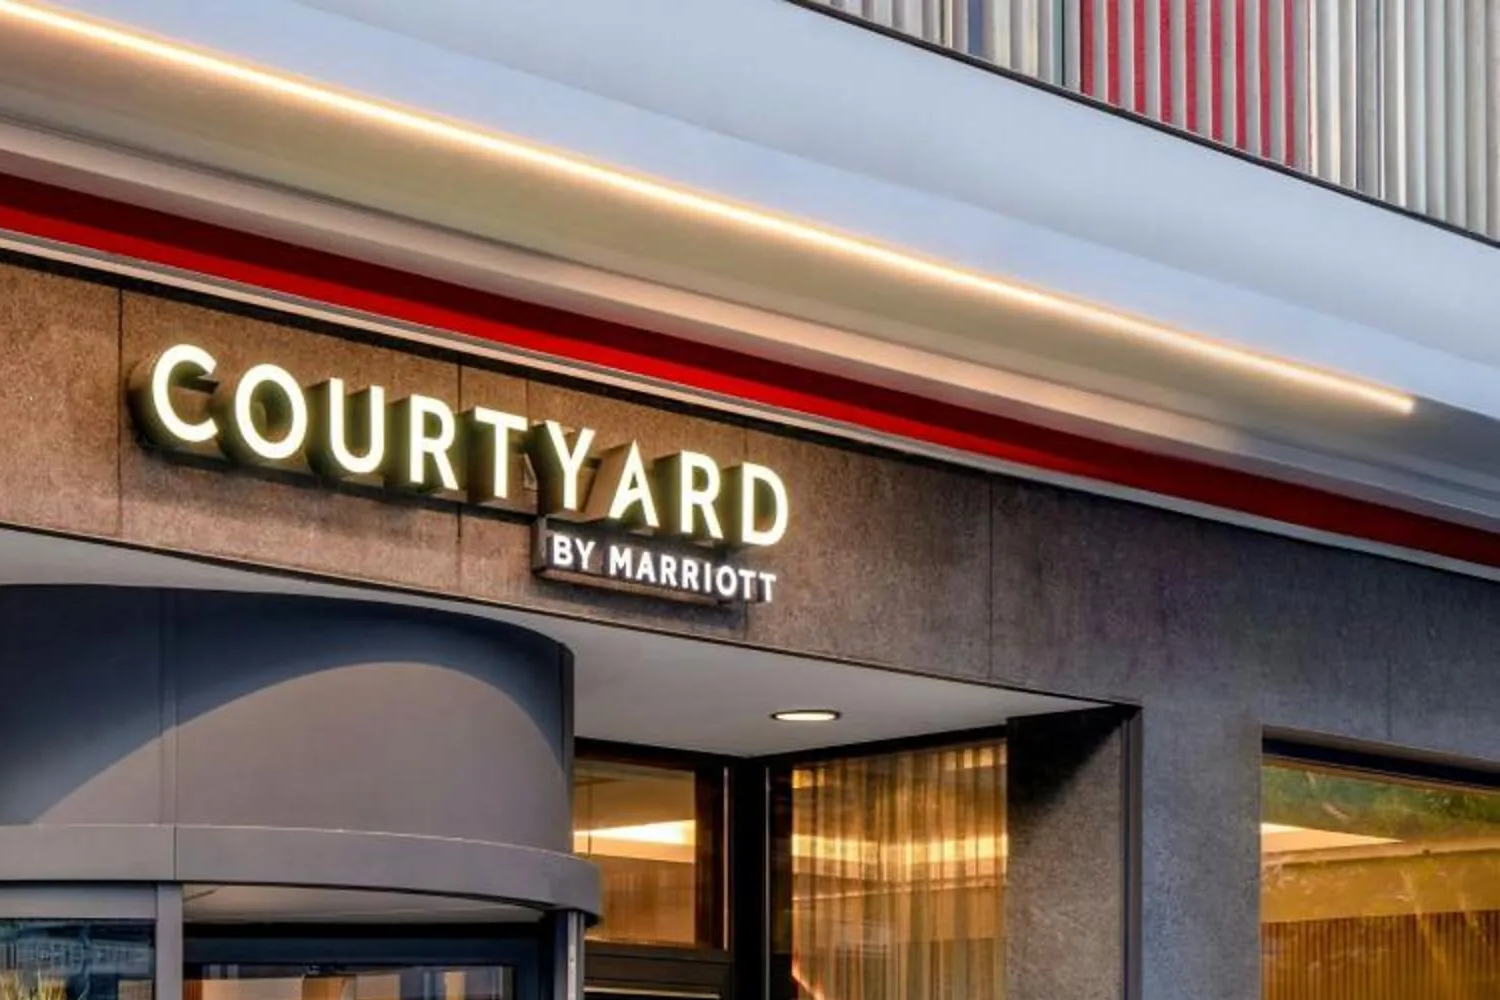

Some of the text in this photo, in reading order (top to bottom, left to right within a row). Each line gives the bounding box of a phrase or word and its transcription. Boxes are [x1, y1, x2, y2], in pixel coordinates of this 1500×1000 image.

[150, 343, 790, 547] COURTYARD
[552, 533, 777, 603] BY MARRIOTT
